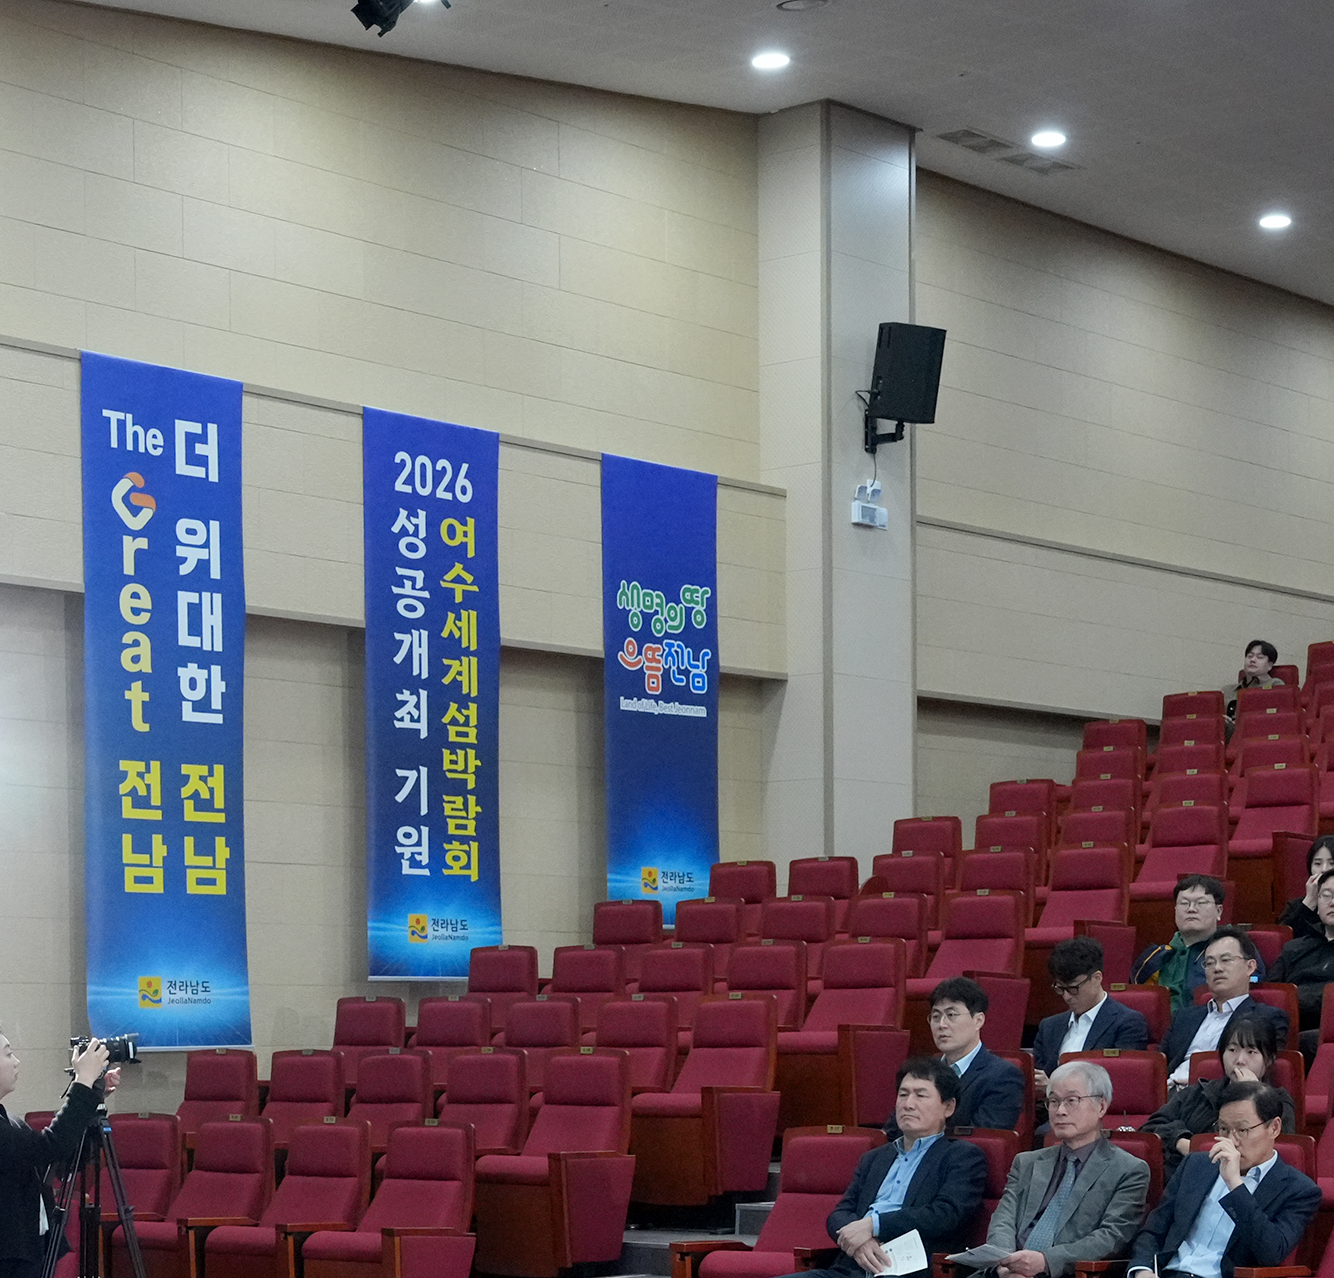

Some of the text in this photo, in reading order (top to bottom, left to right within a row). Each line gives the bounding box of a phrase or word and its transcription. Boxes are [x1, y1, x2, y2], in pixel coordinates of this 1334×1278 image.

[394, 451, 473, 503] 2026
[617, 580, 711, 637] 생명의 땅
[102, 408, 167, 894] The Great 전남
[174, 419, 230, 895] 더 위대한 전남
[618, 637, 711, 694] 으뜸 전남
[390, 507, 431, 876] 성공개최 기원
[439, 516, 482, 882] 여수세계섬박람회
[620, 697, 637, 710] Land
[658, 701, 673, 713] Best
[660, 870, 695, 884] 전라남도
[430, 917, 469, 932] 전라남도
[166, 979, 212, 995] 전라남도
[167, 997, 212, 1005] JeollaNamdo
